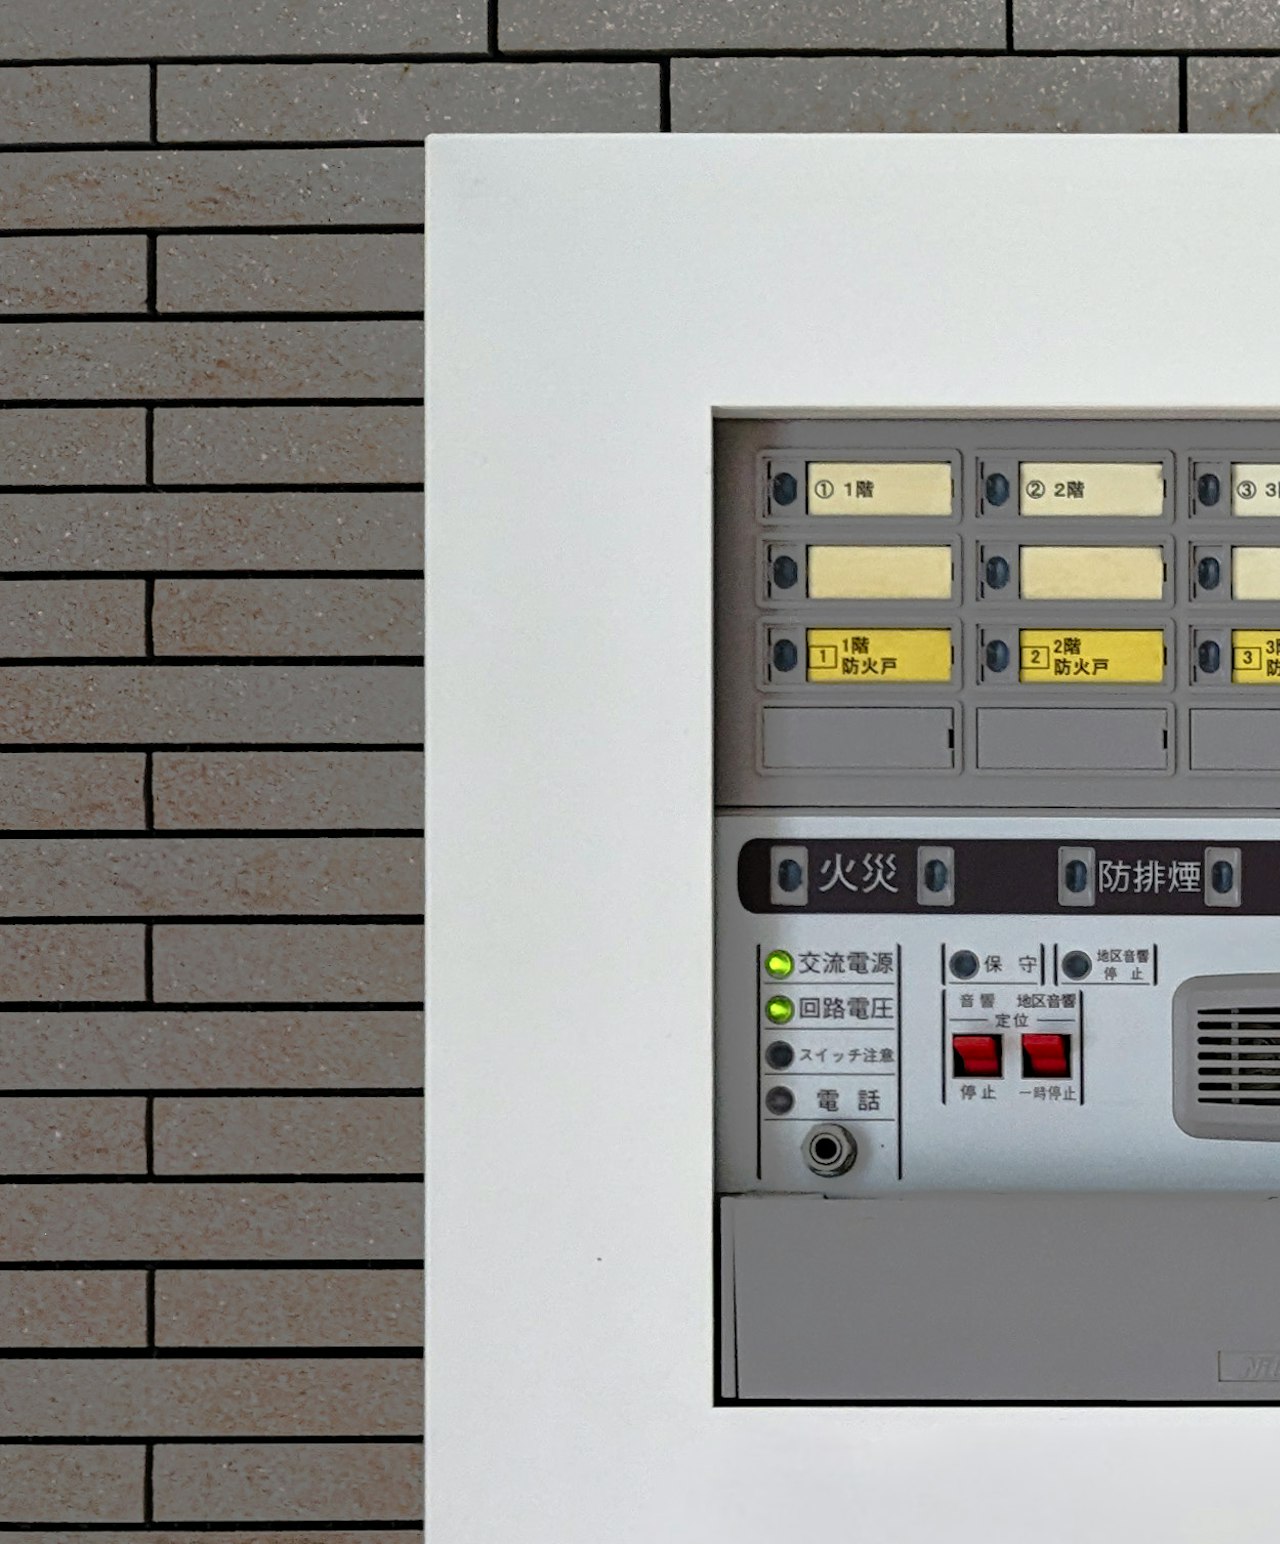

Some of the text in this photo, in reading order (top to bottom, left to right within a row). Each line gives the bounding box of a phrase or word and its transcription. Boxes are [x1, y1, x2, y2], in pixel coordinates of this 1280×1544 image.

[844, 480, 875, 499] 1階
[1053, 480, 1085, 499] 2階
[842, 636, 870, 655] 1階
[1053, 636, 1082, 656] 2階
[841, 656, 898, 676] 防火戸
[1054, 657, 1110, 676] 防火戸
[819, 852, 899, 893] 火災
[1098, 859, 1202, 894] 防排煙
[797, 950, 894, 975] 交流電源
[983, 954, 1038, 974] 保守
[1096, 948, 1150, 964] 地区音響
[1103, 966, 1144, 981] 停止
[798, 996, 894, 1021] 回路電圧
[959, 992, 996, 1009] 音響
[1016, 993, 1077, 1009] 地区音響
[994, 1012, 1029, 1029] 定位
[799, 1047, 896, 1064] スイッチ注意
[816, 1088, 881, 1113] 電話
[959, 1084, 997, 1101] 停止
[1019, 1083, 1078, 1102] 一時停止
